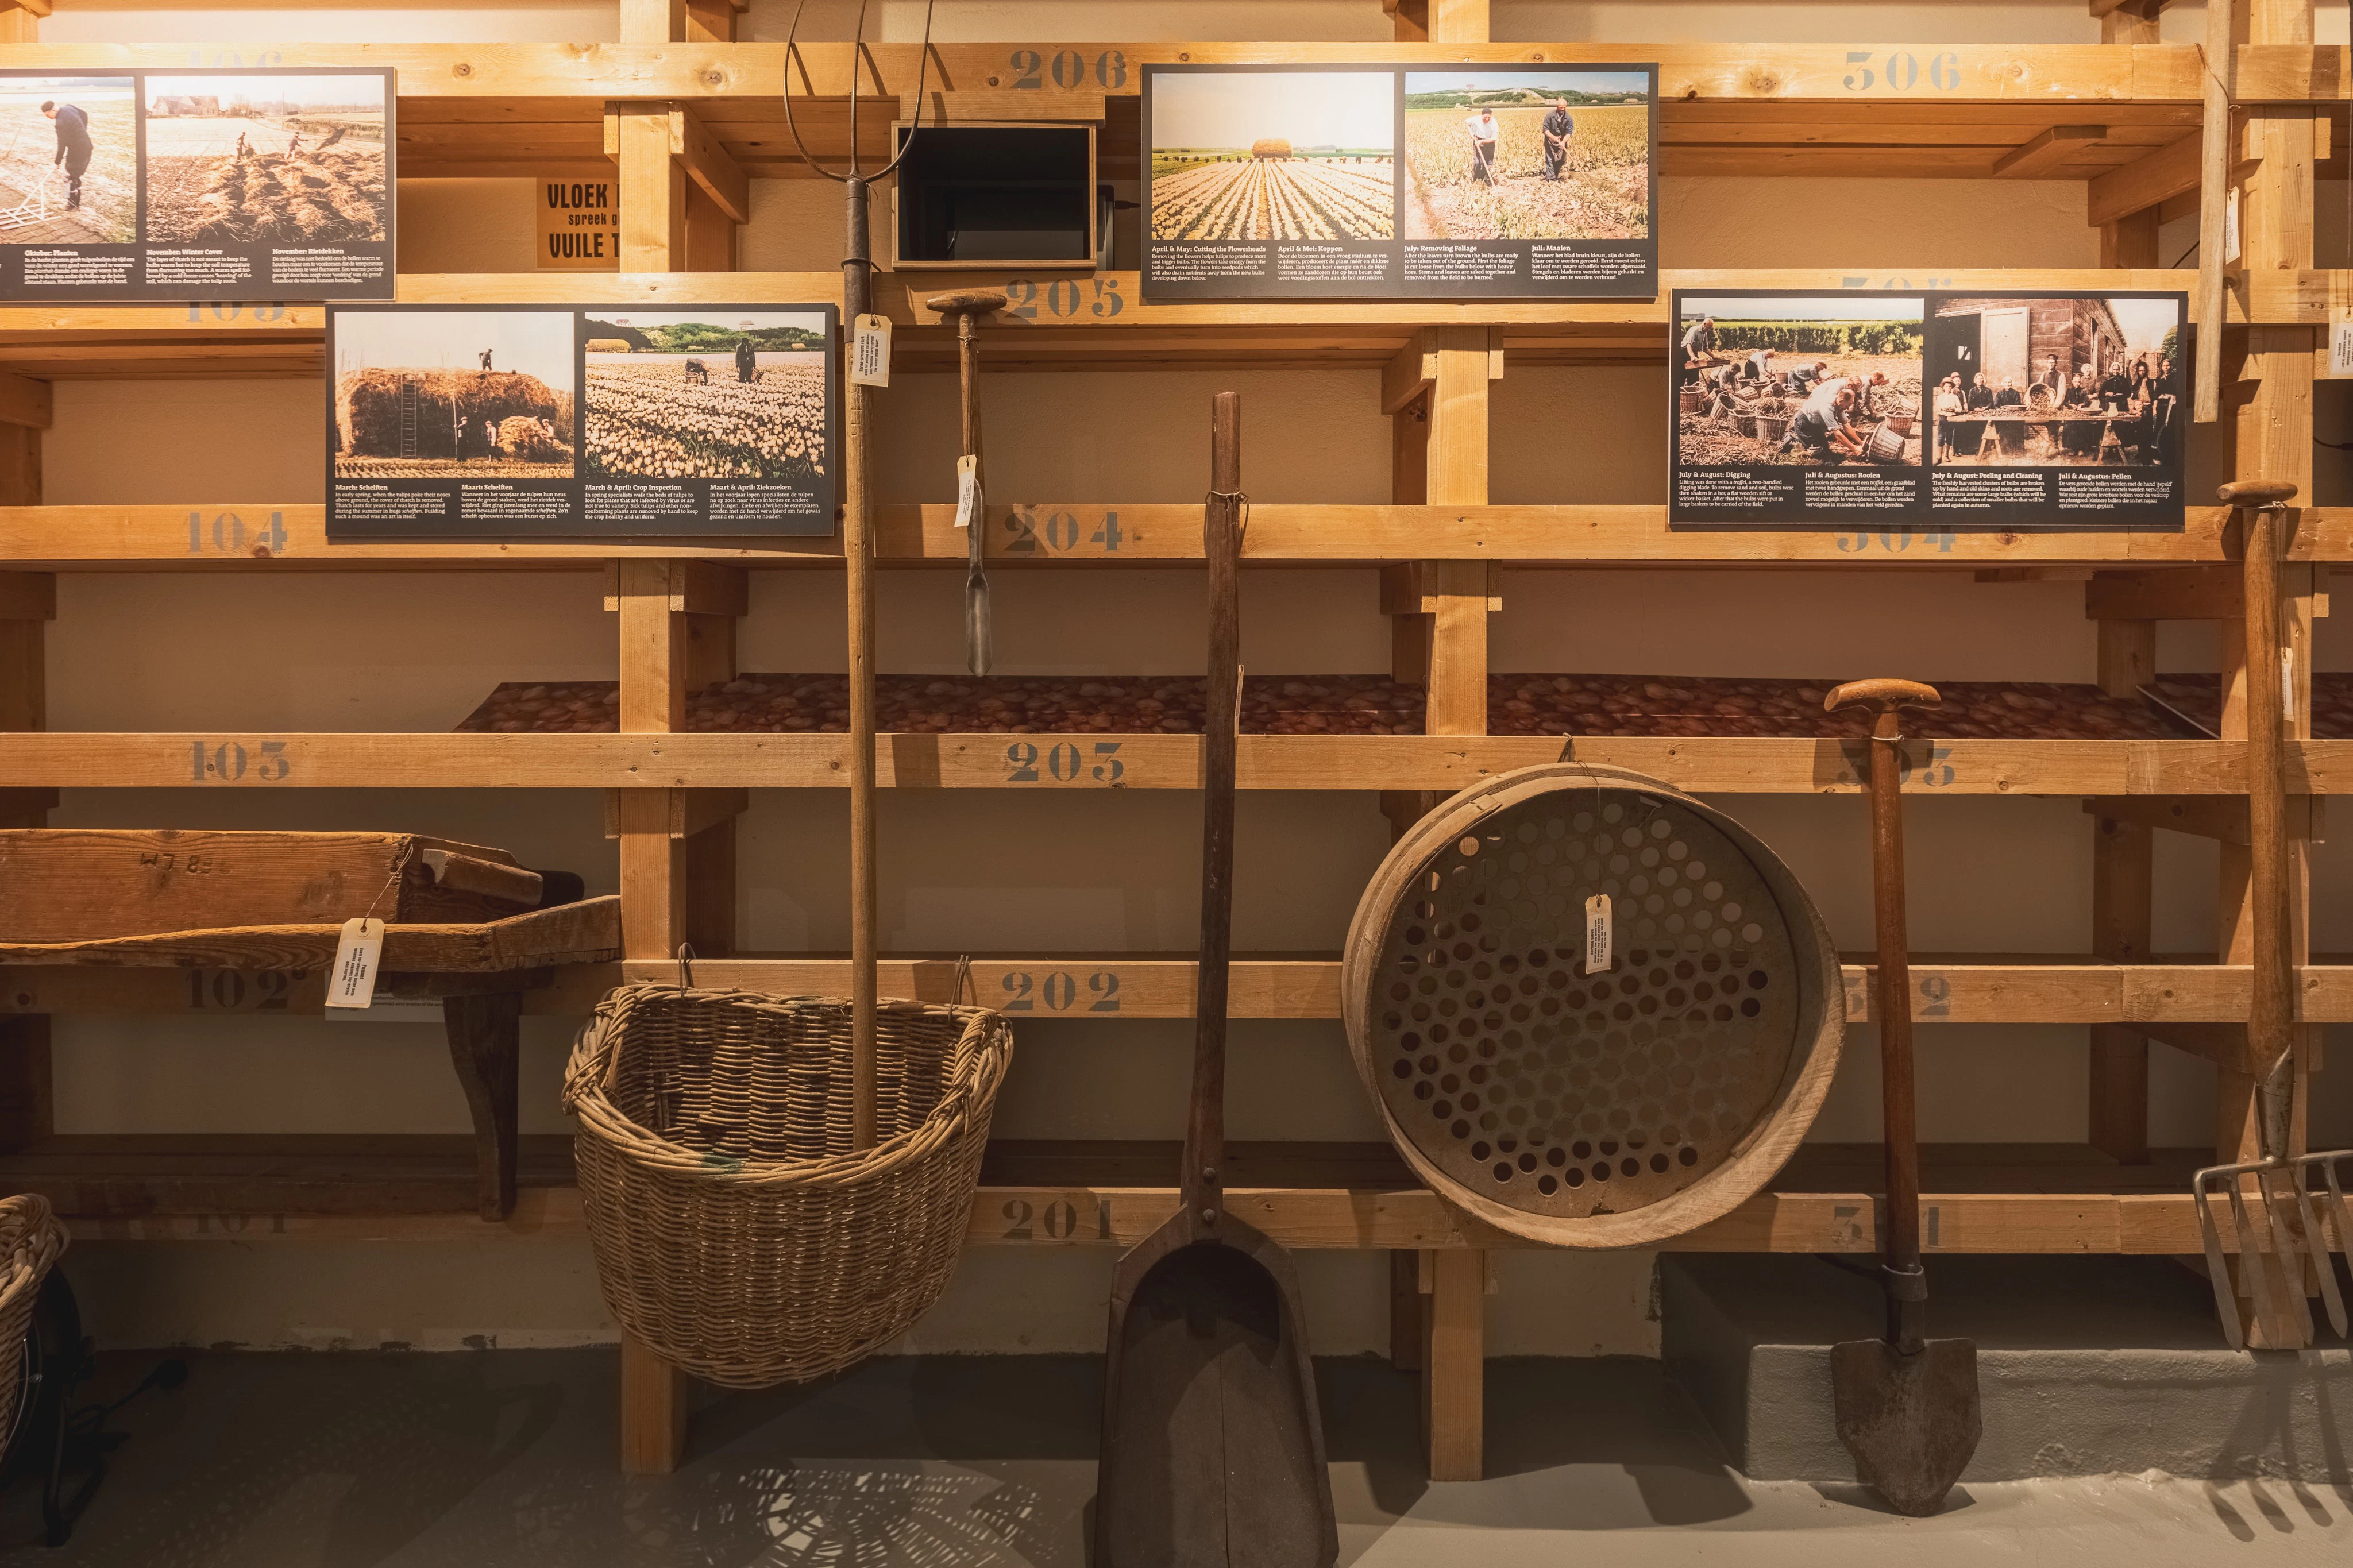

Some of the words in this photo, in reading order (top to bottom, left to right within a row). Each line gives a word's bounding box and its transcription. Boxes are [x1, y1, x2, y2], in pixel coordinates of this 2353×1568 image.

[1009, 50, 1128, 91] 206
[1843, 52, 1961, 91] 306
[547, 184, 607, 208] VLOEK
[569, 213, 607, 226] spreek
[549, 233, 604, 258] VUILE
[1006, 279, 1123, 318] 205
[185, 512, 288, 553] 104
[1003, 512, 1123, 551] 204
[187, 741, 290, 781] 103
[1006, 742, 1124, 782] 203
[186, 969, 287, 1009] 102
[1001, 972, 1120, 1011] 202
[1845, 977, 1951, 1016] 32
[1001, 1199, 1110, 1239] 201
[1831, 1207, 1940, 1246] 31
